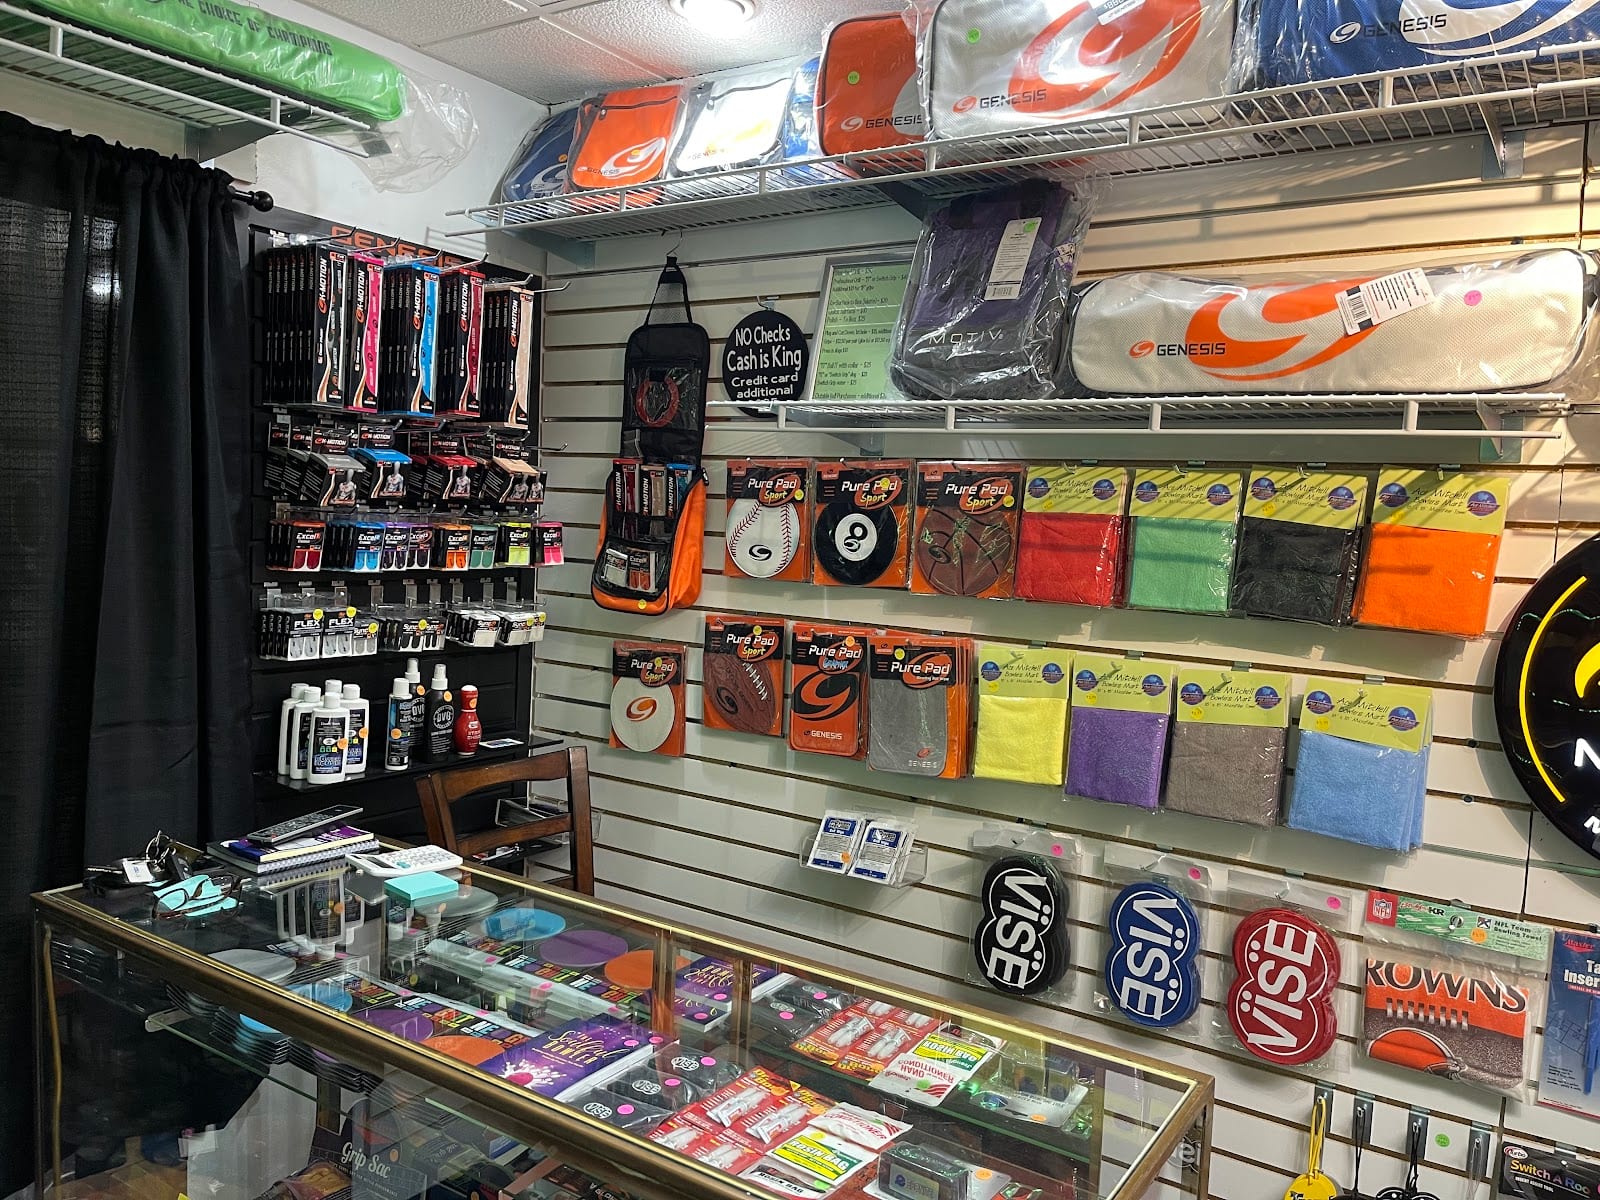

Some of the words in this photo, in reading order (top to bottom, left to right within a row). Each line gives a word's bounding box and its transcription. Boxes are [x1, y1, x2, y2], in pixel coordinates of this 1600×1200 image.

[199, 1, 243, 27] CHOICE
[247, 17, 261, 32] OF
[267, 26, 333, 56] CHAMPIONS
[1363, 14, 1447, 38] GENESIS
[979, 89, 1047, 110] GENESIS
[865, 113, 924, 130] GENESIS
[319, 258, 328, 301] K-MOTION
[357, 270, 366, 311] K-MOTION
[414, 278, 422, 319] K-MOTION
[461, 281, 469, 321] K-MOTION
[511, 299, 519, 336] K-MOTION
[735, 329, 752, 347] NO
[753, 323, 791, 345] Checks
[929, 329, 1003, 346] MOTIV
[1156, 342, 1226, 358] GENESIS
[727, 350, 757, 371] Cash
[759, 347, 769, 369] is
[772, 345, 801, 371] King
[731, 373, 768, 387] Credit
[771, 372, 798, 384] card
[737, 384, 794, 399] additional
[748, 479, 774, 490] Pure
[776, 479, 797, 490] Pad
[841, 481, 870, 492] Pure
[945, 484, 976, 495] Pure
[981, 483, 1009, 496] Pad
[764, 489, 787, 501] Sport
[860, 491, 887, 504] Sport
[966, 495, 997, 510] Sport
[294, 619, 320, 628] FLEX
[329, 618, 353, 627] FLEX
[726, 634, 750, 644] Pure
[754, 635, 775, 645] Pad
[742, 646, 766, 660] Sport
[809, 644, 836, 656] Pure
[838, 647, 862, 659] Pad
[631, 659, 652, 670] Pure
[891, 662, 921, 673] Pure
[924, 663, 950, 675] Pad
[645, 672, 666, 681] Sport
[811, 730, 842, 740] GENESIS
[1374, 907, 1391, 918] NFL
[1494, 926, 1520, 937] Bowling
[1522, 933, 1542, 941] Towel
[1512, 924, 1531, 933] Team
[549, 1030, 630, 1059] Soulful
[542, 1040, 601, 1065] BOWLER
[341, 1142, 366, 1170] Grip
[368, 1155, 391, 1179] Sac
[789, 1138, 823, 1161] ROSIN
[823, 1151, 849, 1172] BAG
[1510, 1159, 1550, 1181] Switch
[1553, 1174, 1562, 1185] A
[757, 1171, 784, 1187] ROSIN
[784, 1182, 804, 1194] BAG
